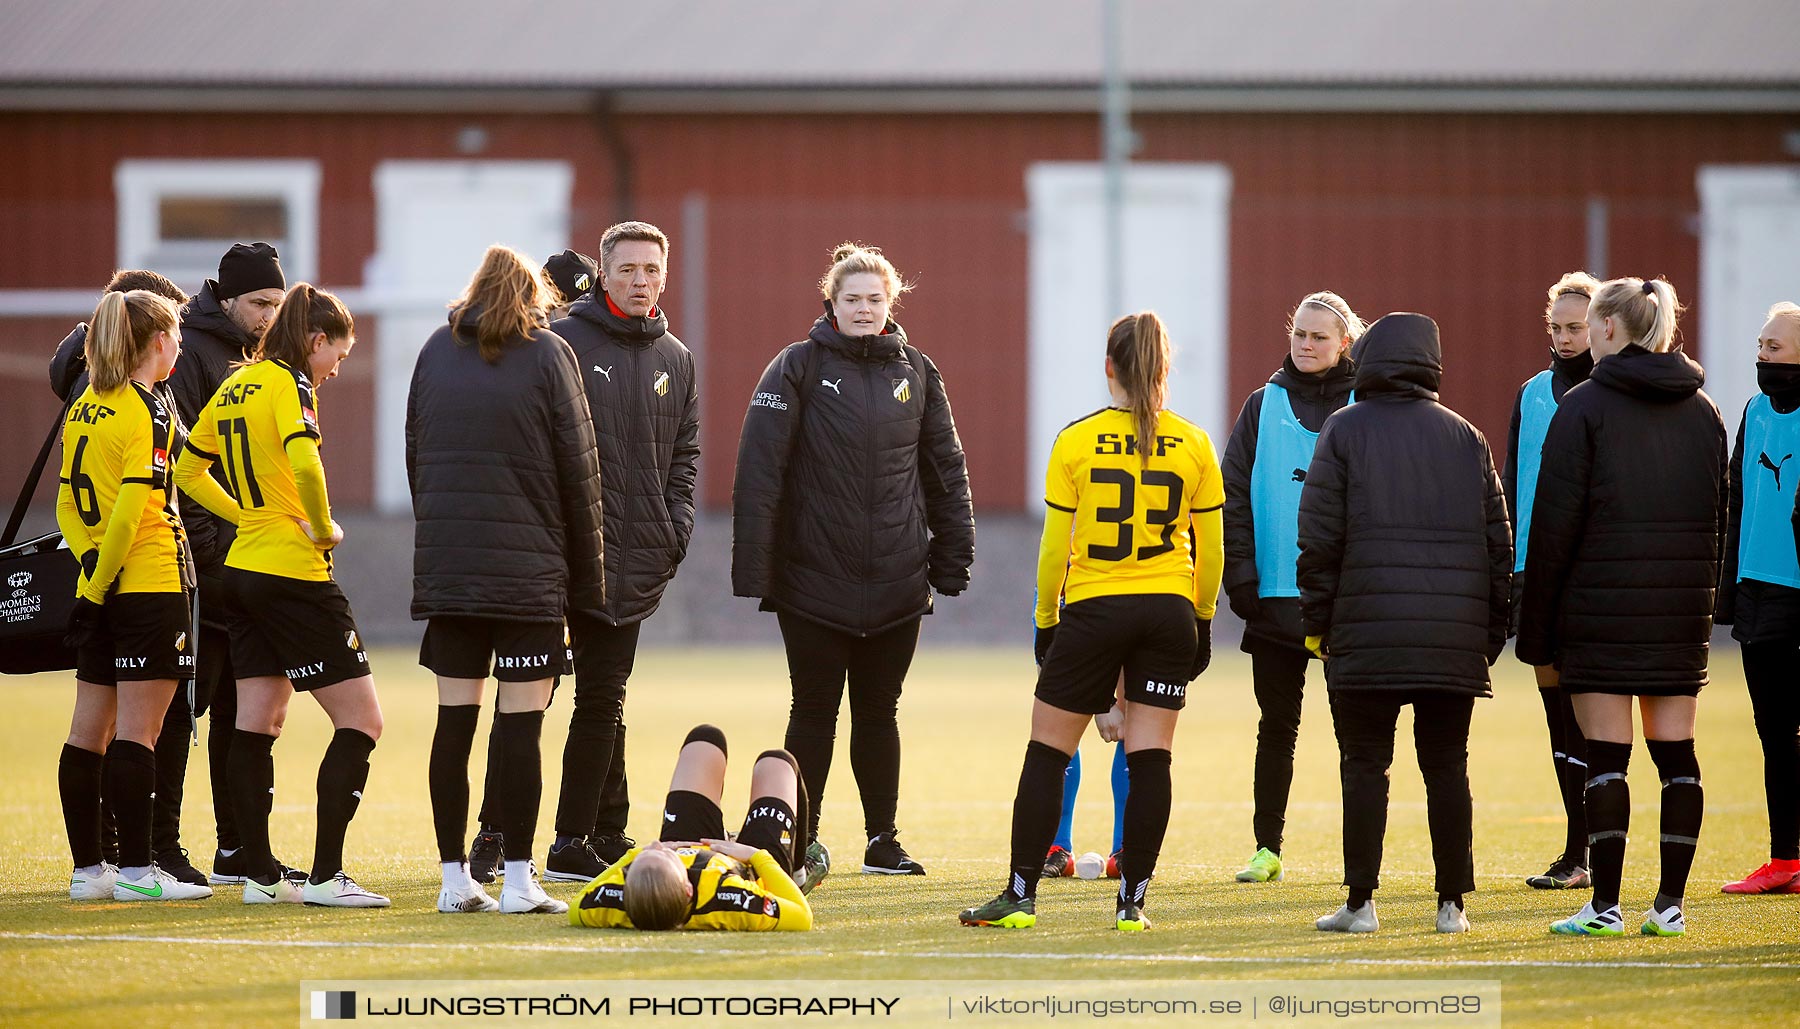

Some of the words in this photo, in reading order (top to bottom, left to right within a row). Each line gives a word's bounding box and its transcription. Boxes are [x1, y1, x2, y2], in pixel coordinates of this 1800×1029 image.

[216, 384, 262, 407] SKF
[70, 435, 101, 527] 6
[217, 417, 265, 509] 11
[1088, 468, 1184, 561] 33
[285, 662, 324, 680] BRIXLY
[498, 654, 549, 668] BRIXLY
